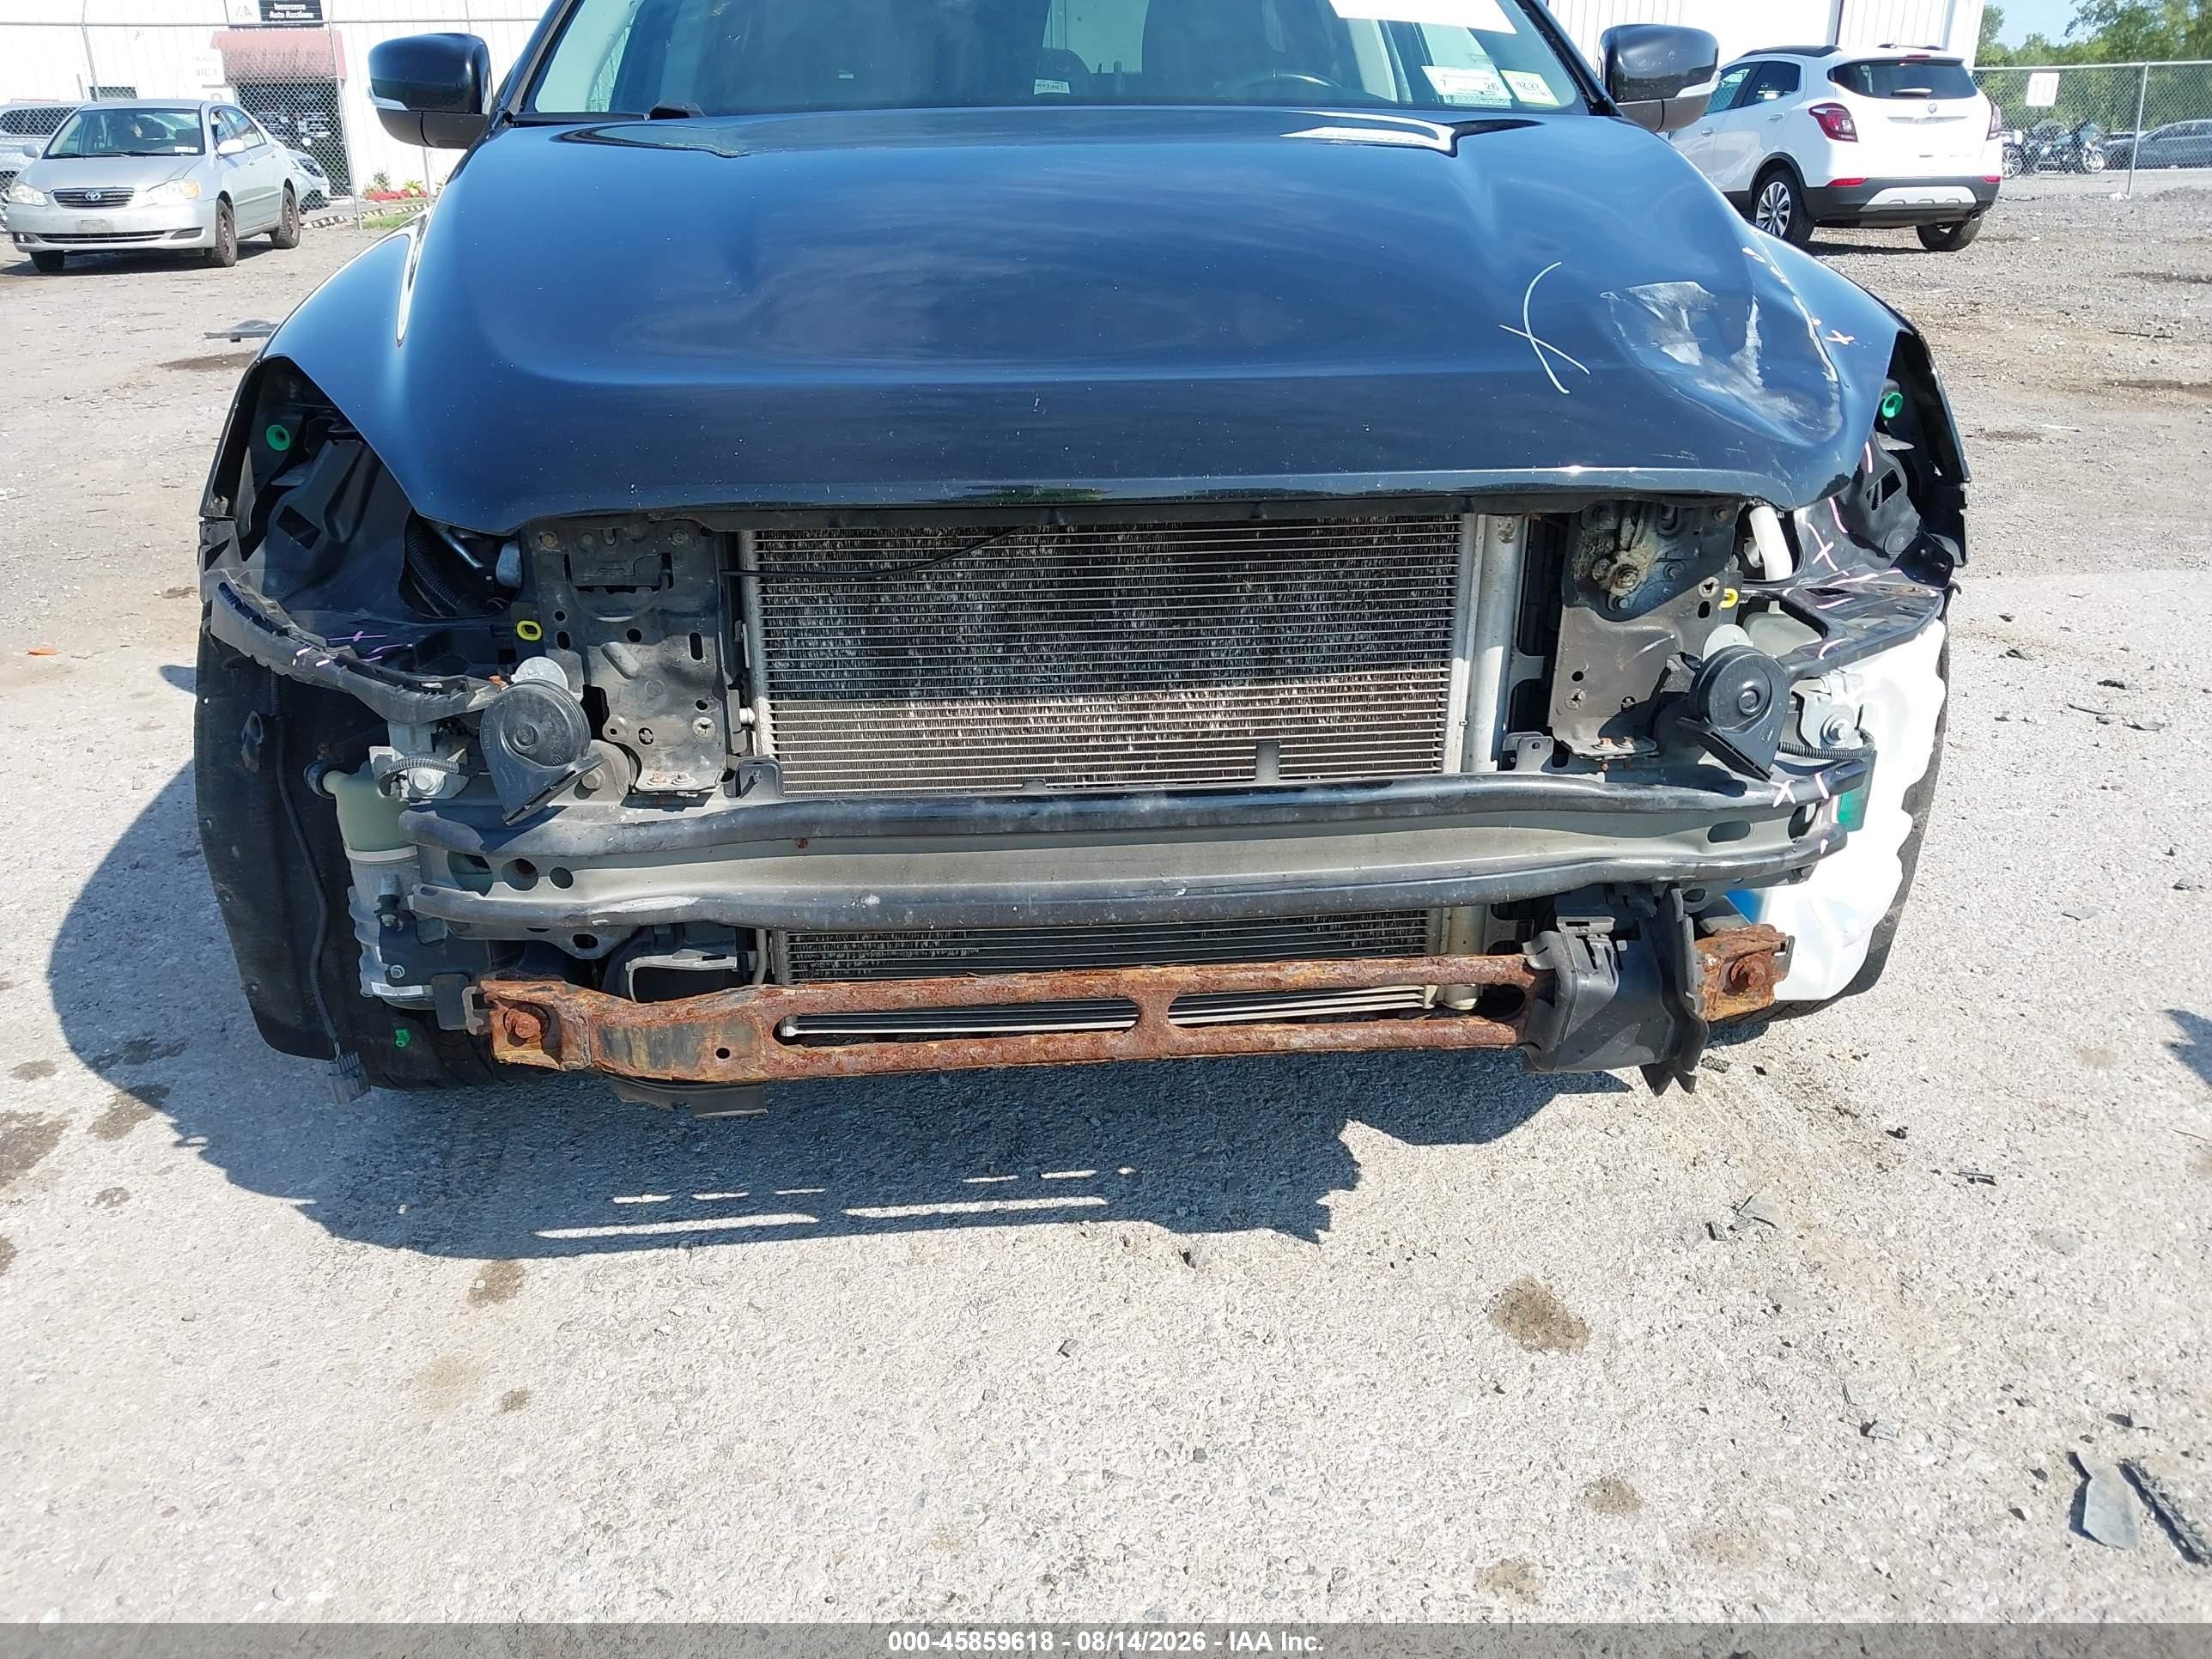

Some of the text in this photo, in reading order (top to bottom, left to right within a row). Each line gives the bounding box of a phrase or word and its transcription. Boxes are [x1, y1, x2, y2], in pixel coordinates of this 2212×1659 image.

[269, 10, 314, 19] Auto Auctions
[2033, 78, 2055, 102] 10
